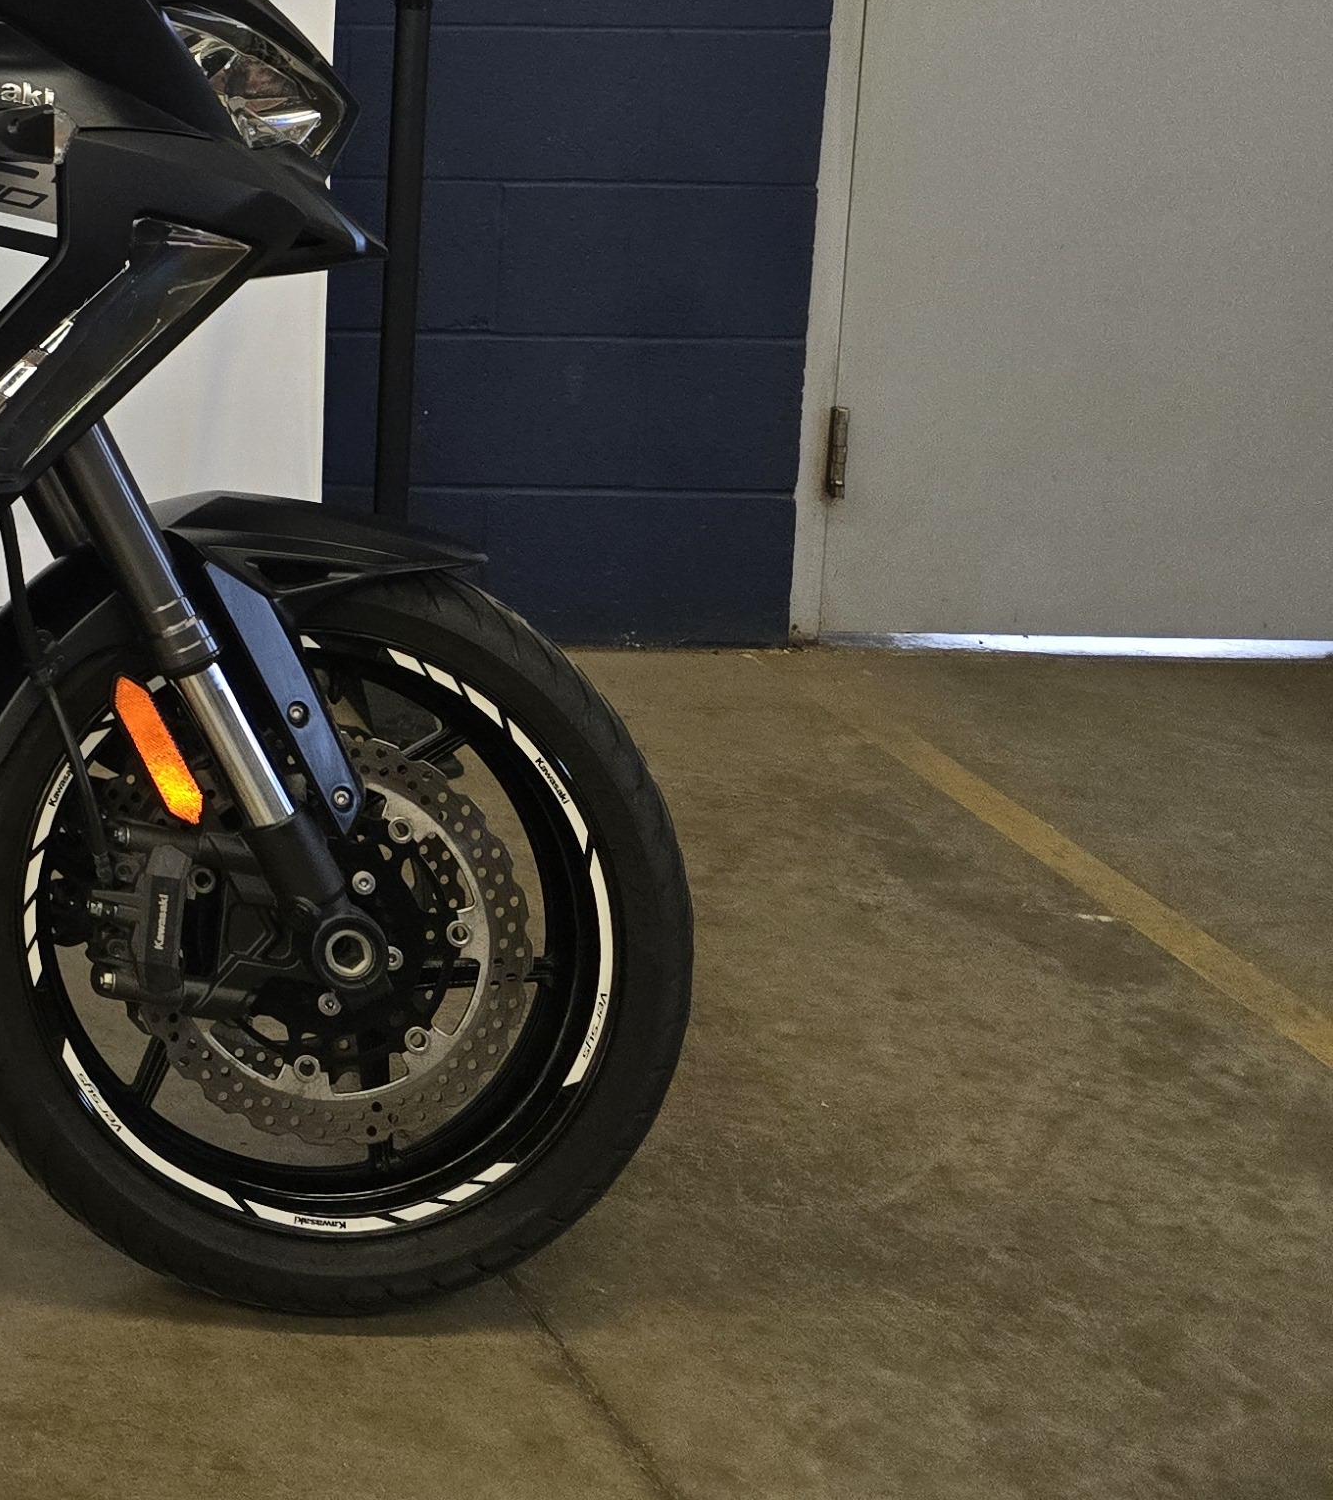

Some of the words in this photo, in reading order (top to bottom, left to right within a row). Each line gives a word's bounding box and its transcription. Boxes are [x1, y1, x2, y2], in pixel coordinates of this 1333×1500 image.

[48, 764, 74, 807] Kawasa
[535, 757, 570, 805] Kawasaki
[154, 893, 169, 951] Kawasaki
[293, 1215, 347, 1230] Kawasaki
